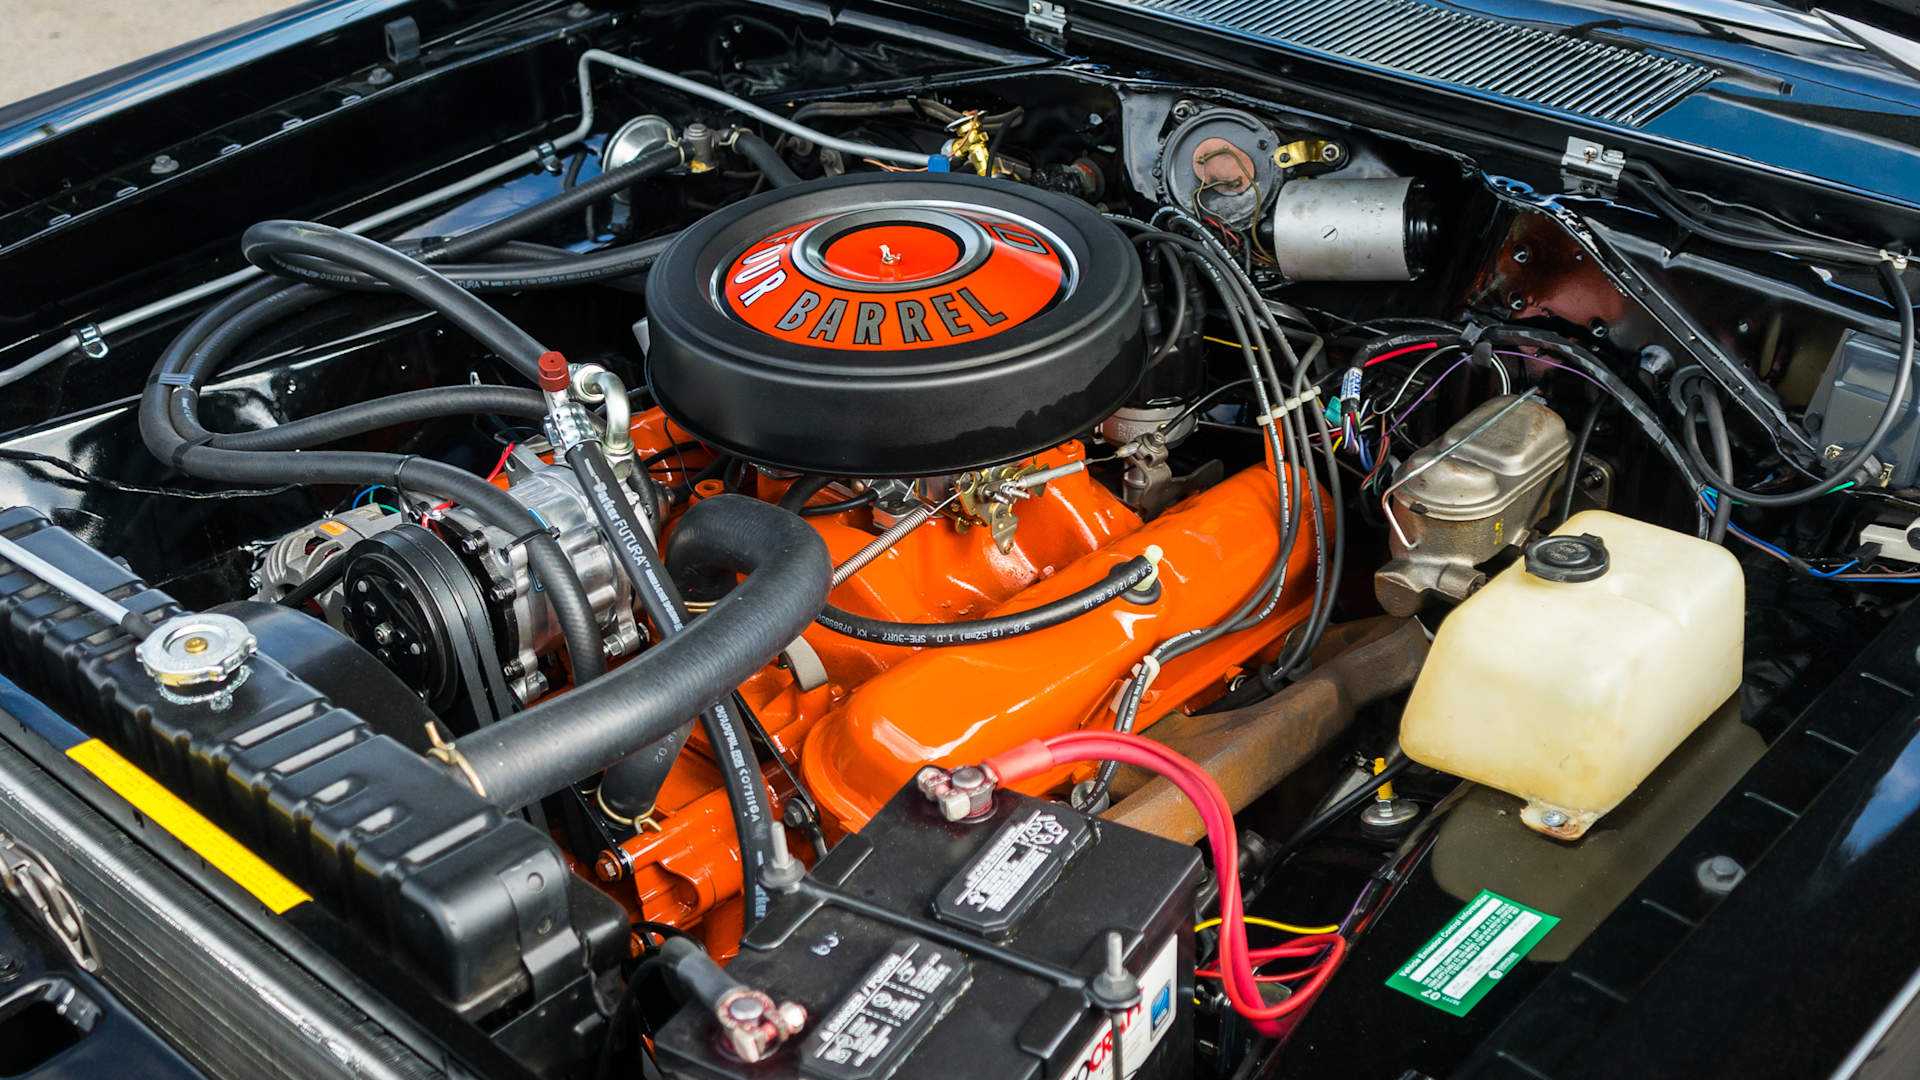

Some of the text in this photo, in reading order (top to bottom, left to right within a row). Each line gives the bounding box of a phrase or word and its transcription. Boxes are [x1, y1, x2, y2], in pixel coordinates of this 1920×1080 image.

[775, 287, 1008, 345] BARREL
[1399, 958, 1422, 977] Vehicle
[1419, 937, 1443, 960] Emission
[1441, 919, 1462, 938] Control
[1460, 894, 1490, 923] Information
